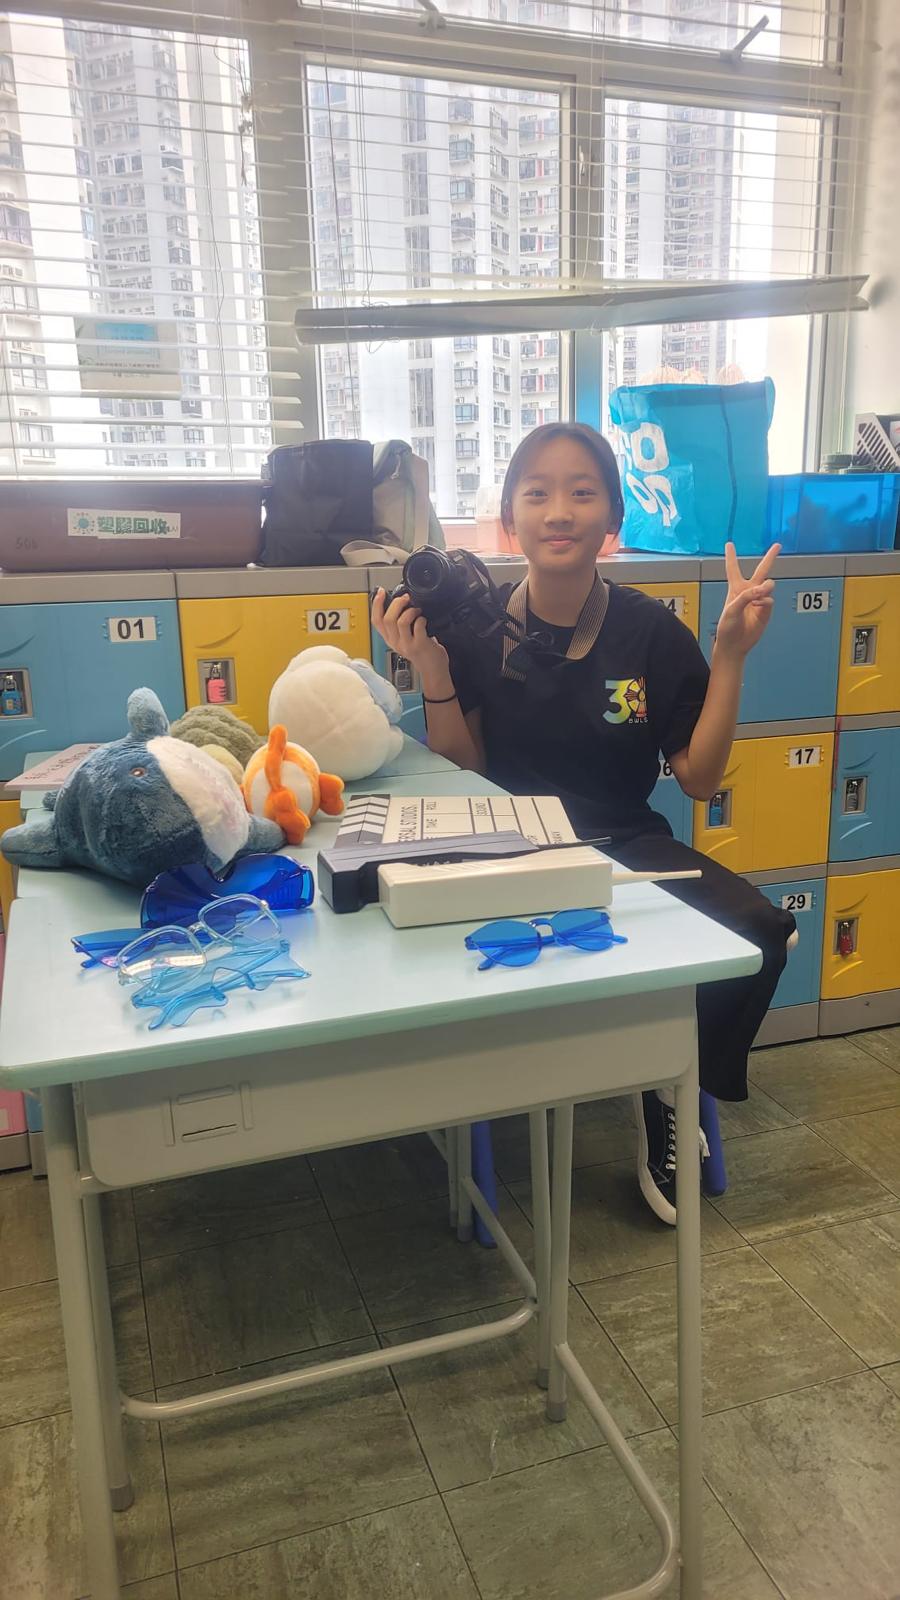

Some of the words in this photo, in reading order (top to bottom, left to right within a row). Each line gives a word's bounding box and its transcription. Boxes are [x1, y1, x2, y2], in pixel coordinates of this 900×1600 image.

[802, 593, 823, 610] 05
[117, 618, 144, 640] 01
[314, 611, 341, 631] 02
[795, 748, 815, 765] 17
[787, 894, 806, 911] 29
